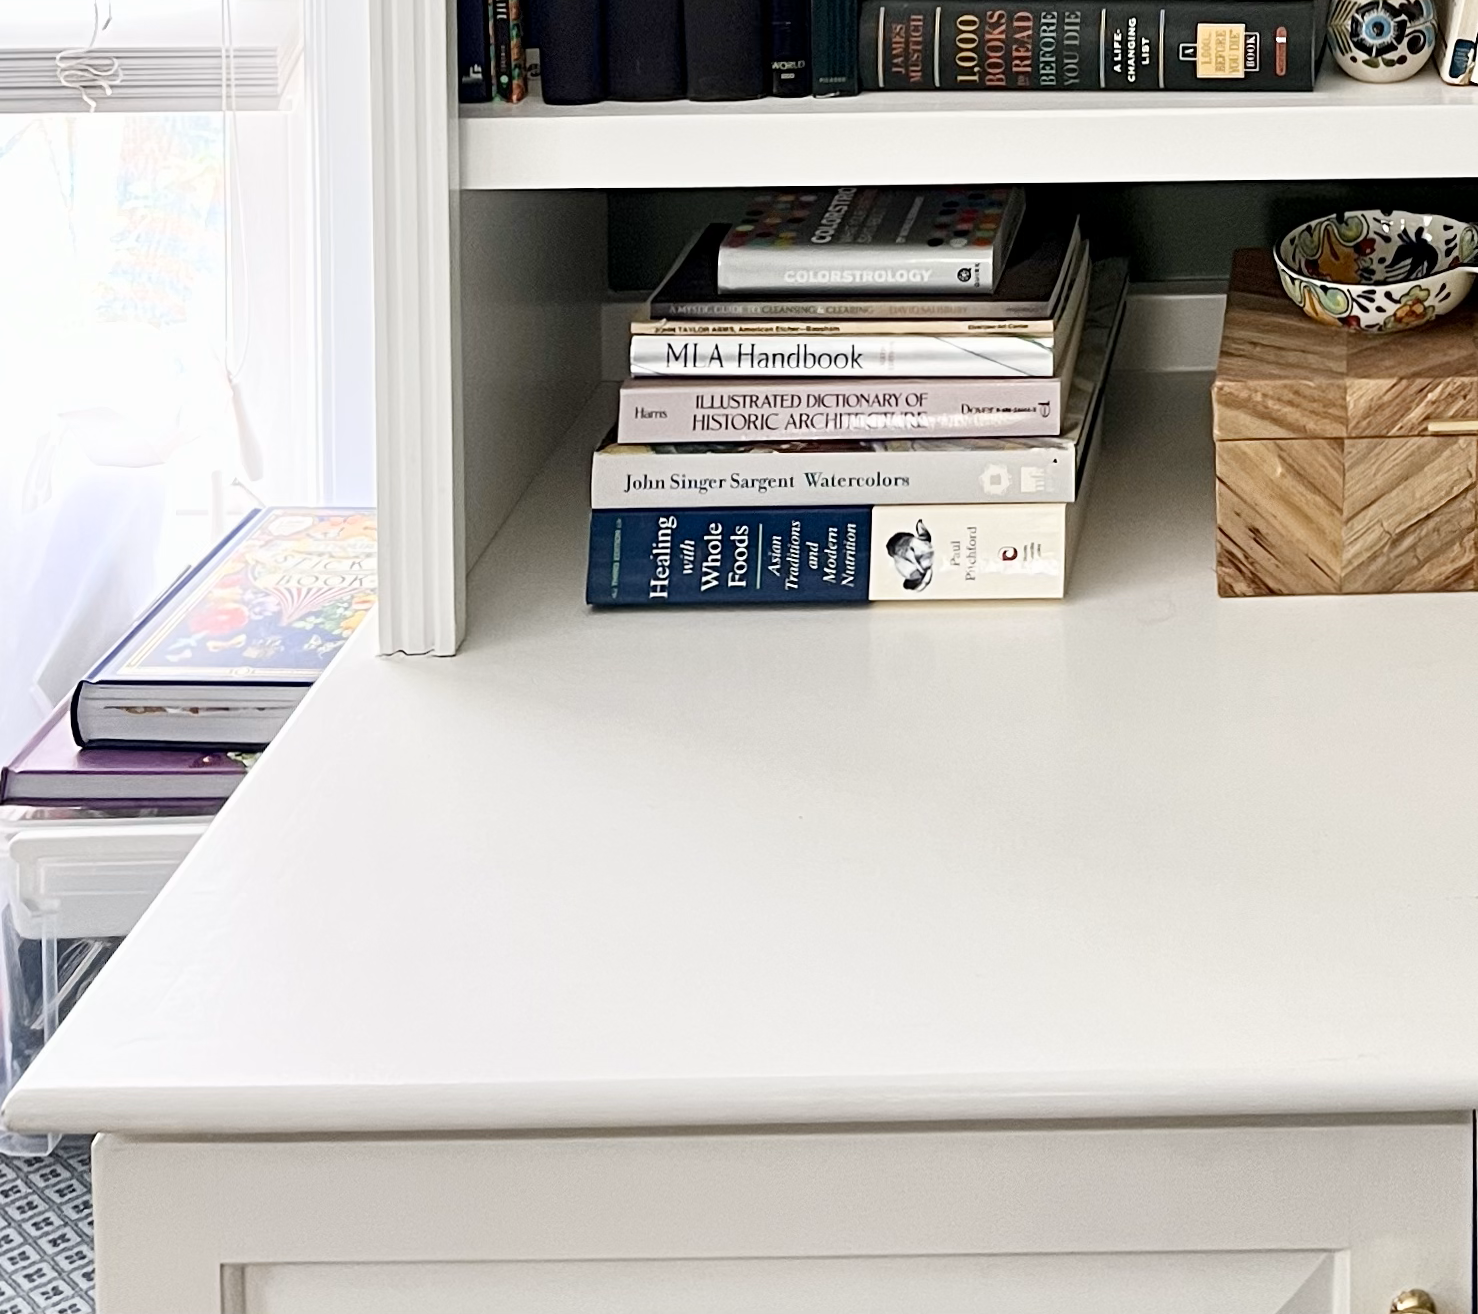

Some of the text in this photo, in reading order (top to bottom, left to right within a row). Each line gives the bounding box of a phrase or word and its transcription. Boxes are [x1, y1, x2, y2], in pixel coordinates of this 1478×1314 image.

[665, 343, 862, 369] MLA Handbook
[624, 472, 909, 493] John Singer Sargent Watercolors
[650, 516, 677, 599] Healing
[679, 539, 696, 575] with
[700, 523, 722, 592] Whole
[727, 526, 749, 589] Foods
